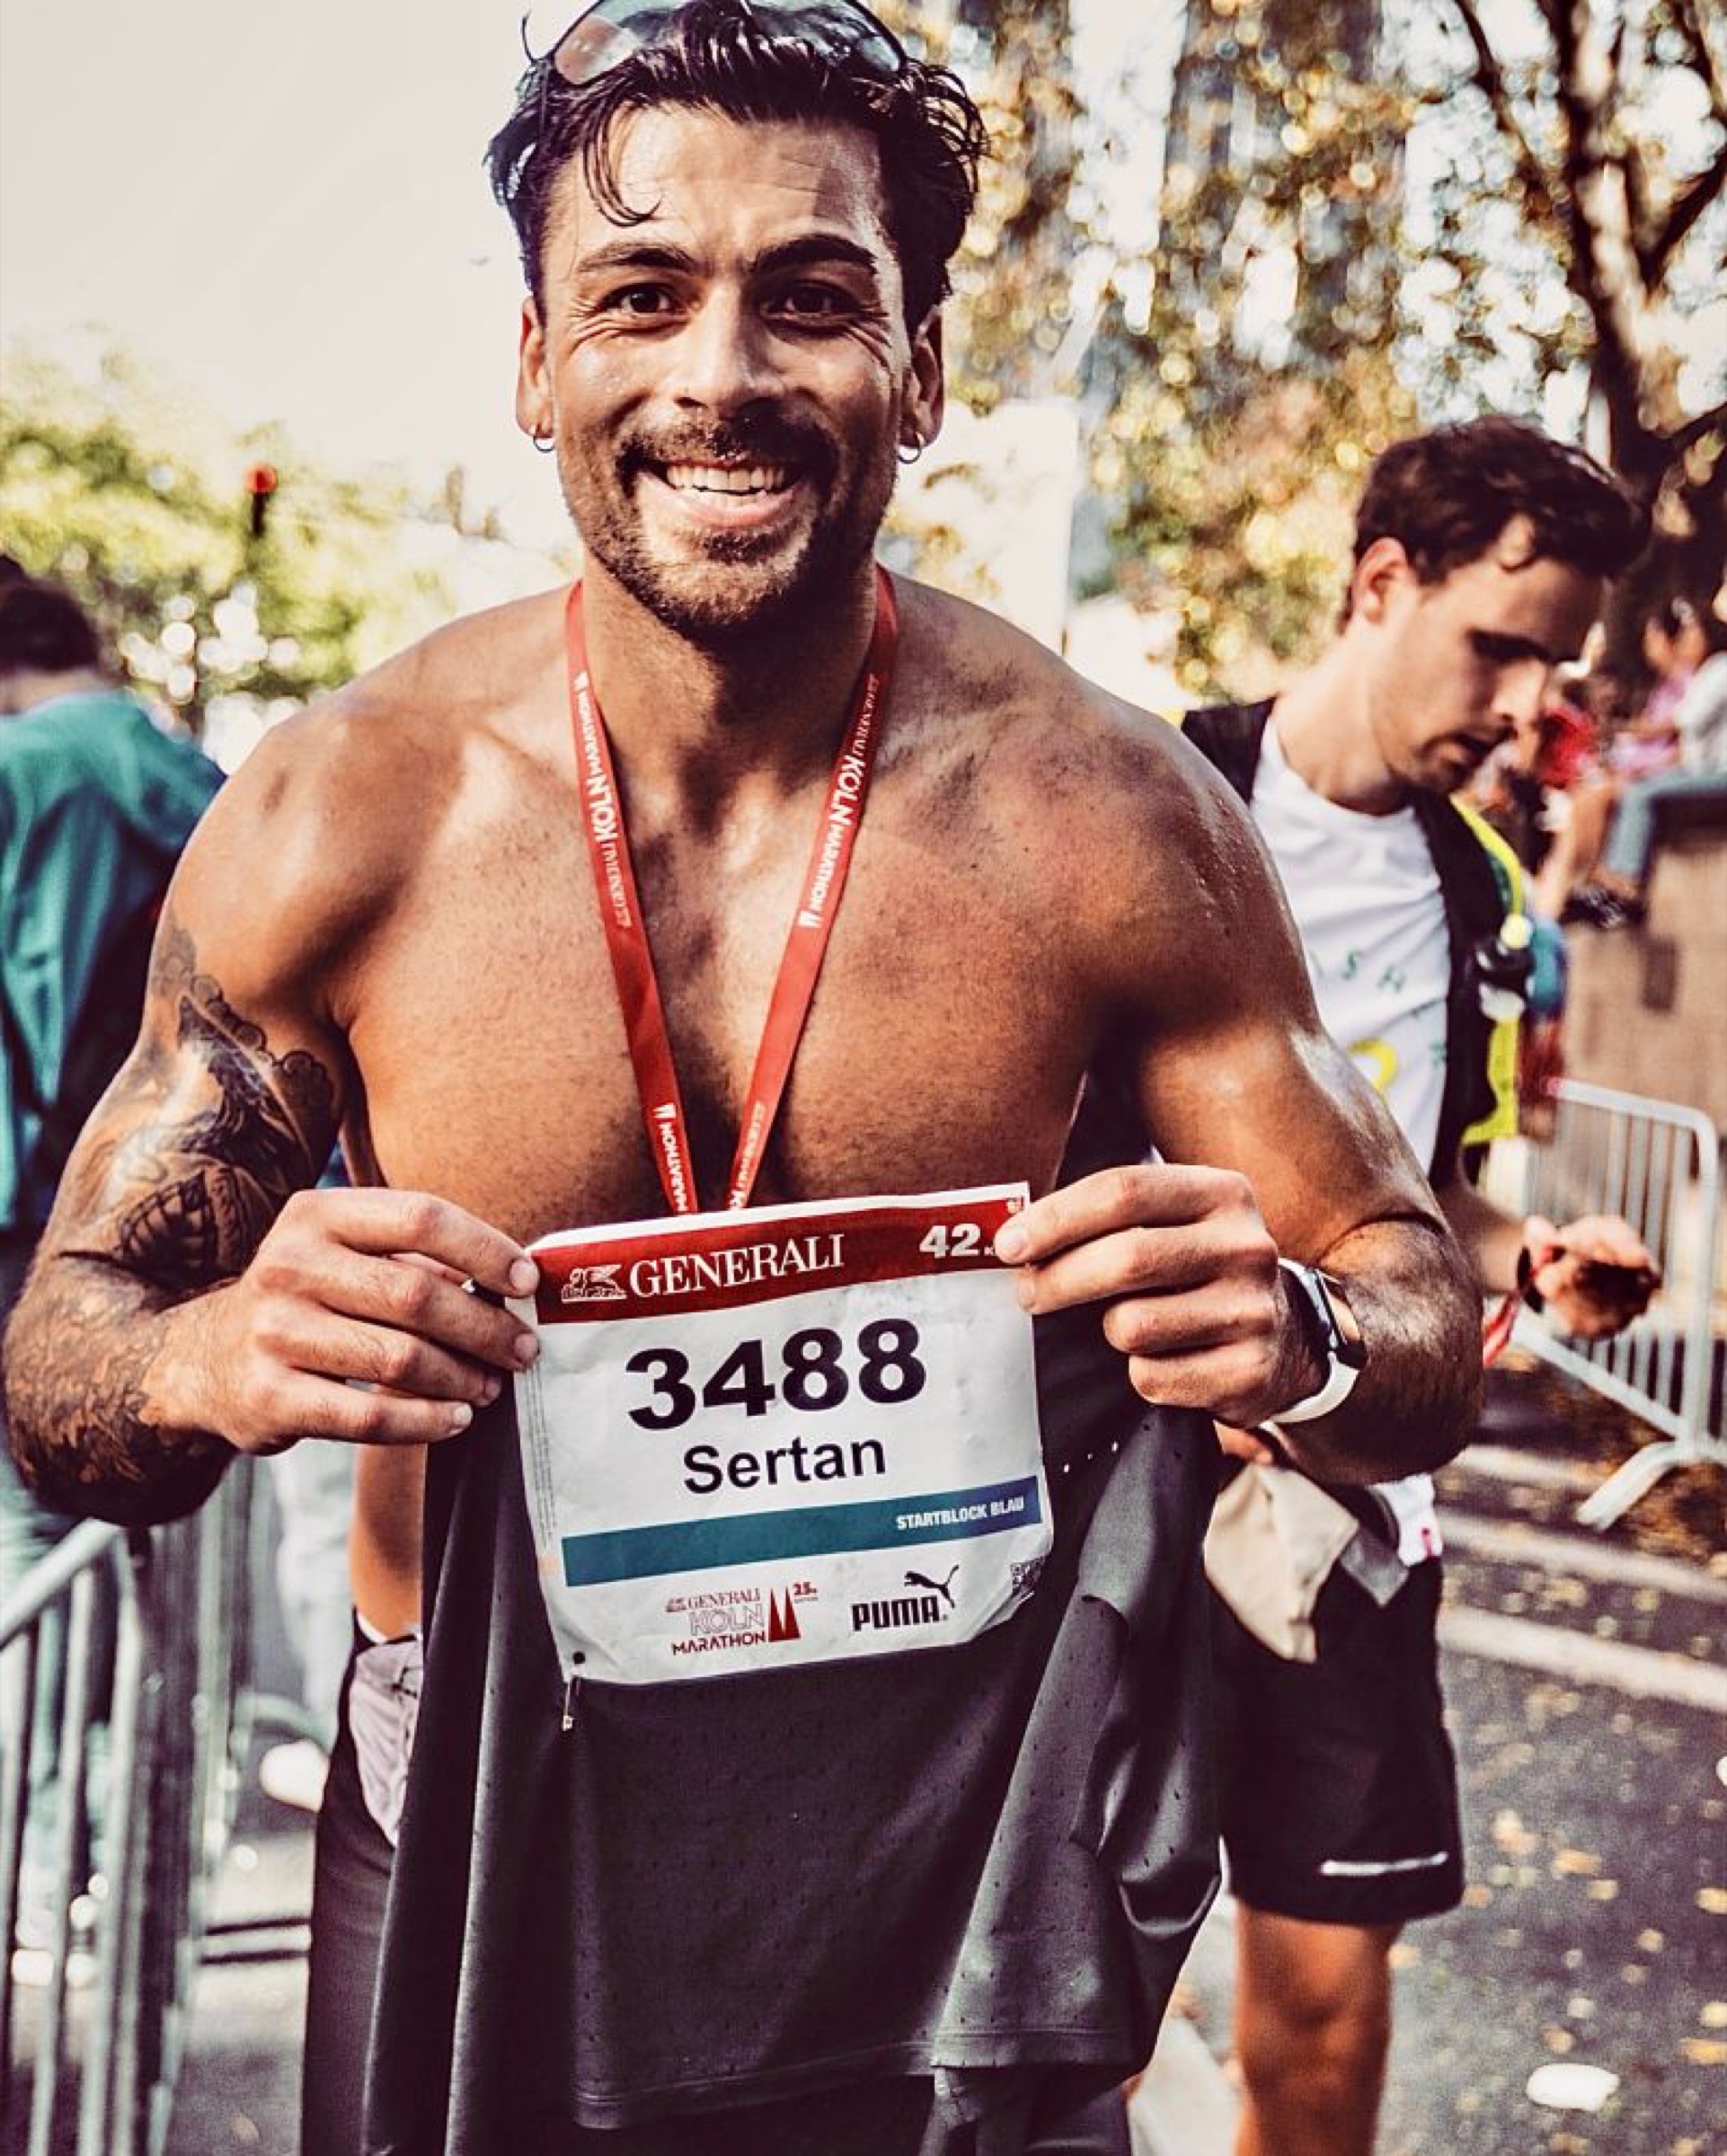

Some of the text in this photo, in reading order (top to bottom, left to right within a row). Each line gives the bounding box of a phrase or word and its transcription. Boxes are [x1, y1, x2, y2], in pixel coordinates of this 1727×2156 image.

[919, 1223, 981, 1259] 42
[629, 1233, 845, 1298] GENERALI
[625, 1318, 926, 1430] 3488
[683, 1437, 887, 1494] Sertan
[896, 1496, 1025, 1531] STARTBLOCK BLAU
[687, 1587, 761, 1610] GENERALI
[851, 1595, 941, 1632] PUMA
[672, 1631, 766, 1656] MARATHON
